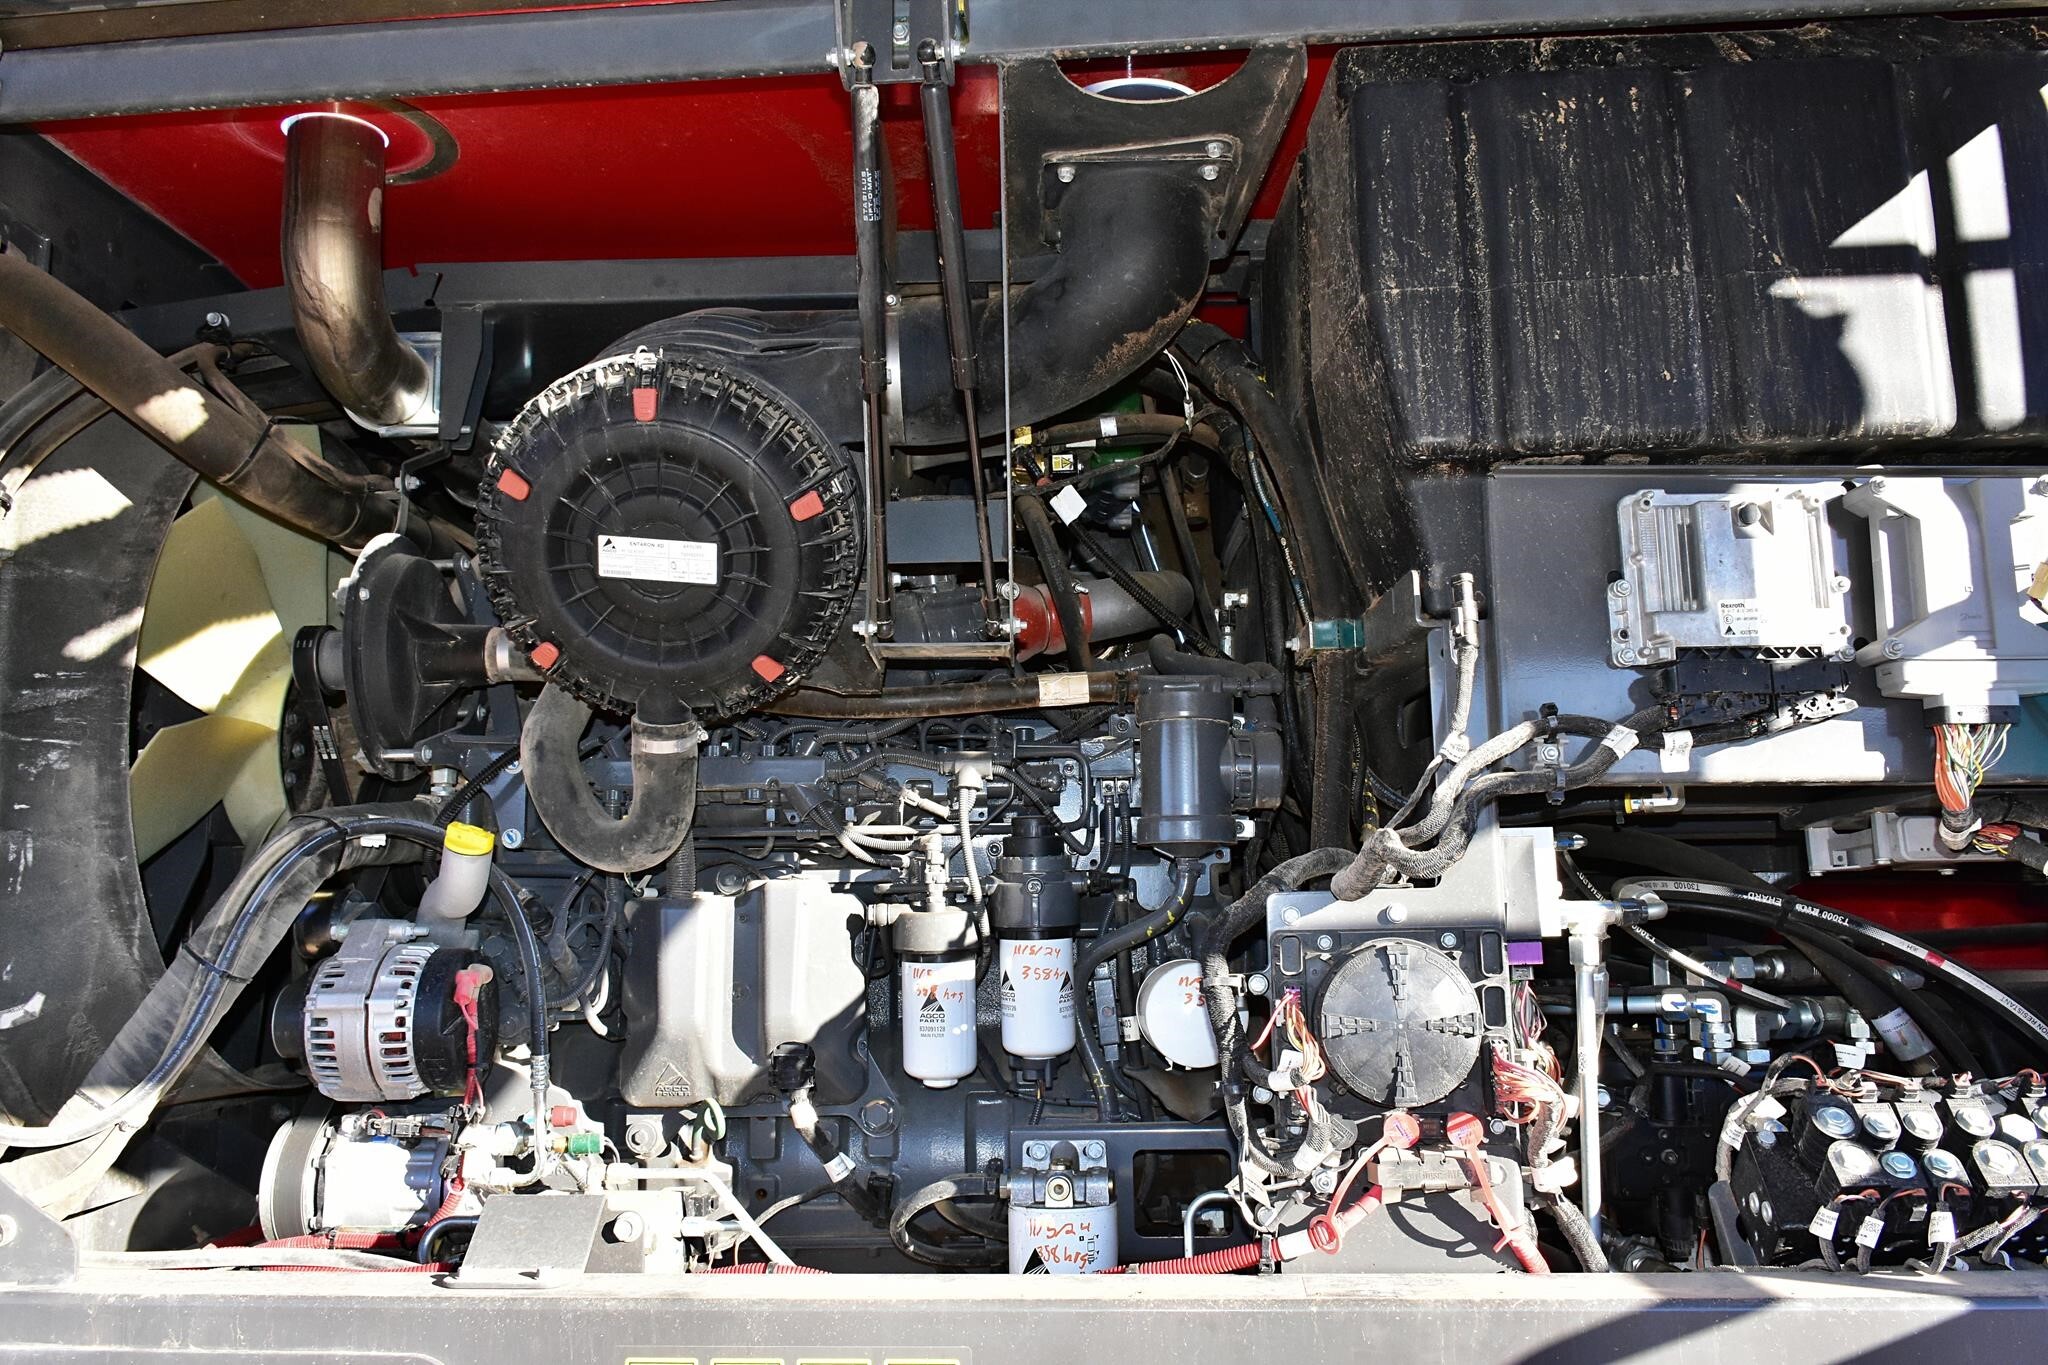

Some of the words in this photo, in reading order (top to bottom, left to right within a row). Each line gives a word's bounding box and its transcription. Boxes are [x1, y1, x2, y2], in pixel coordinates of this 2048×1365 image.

[861, 171, 869, 221] STABILUS
[1577, 871, 1605, 902] IEHARD
[1672, 881, 1702, 893] T3010D
[1747, 890, 1783, 907] EHARD
[1821, 909, 1850, 927] T3000
[2000, 996, 2038, 1025] RESISTANT
[1037, 1244, 1060, 1264] 358
